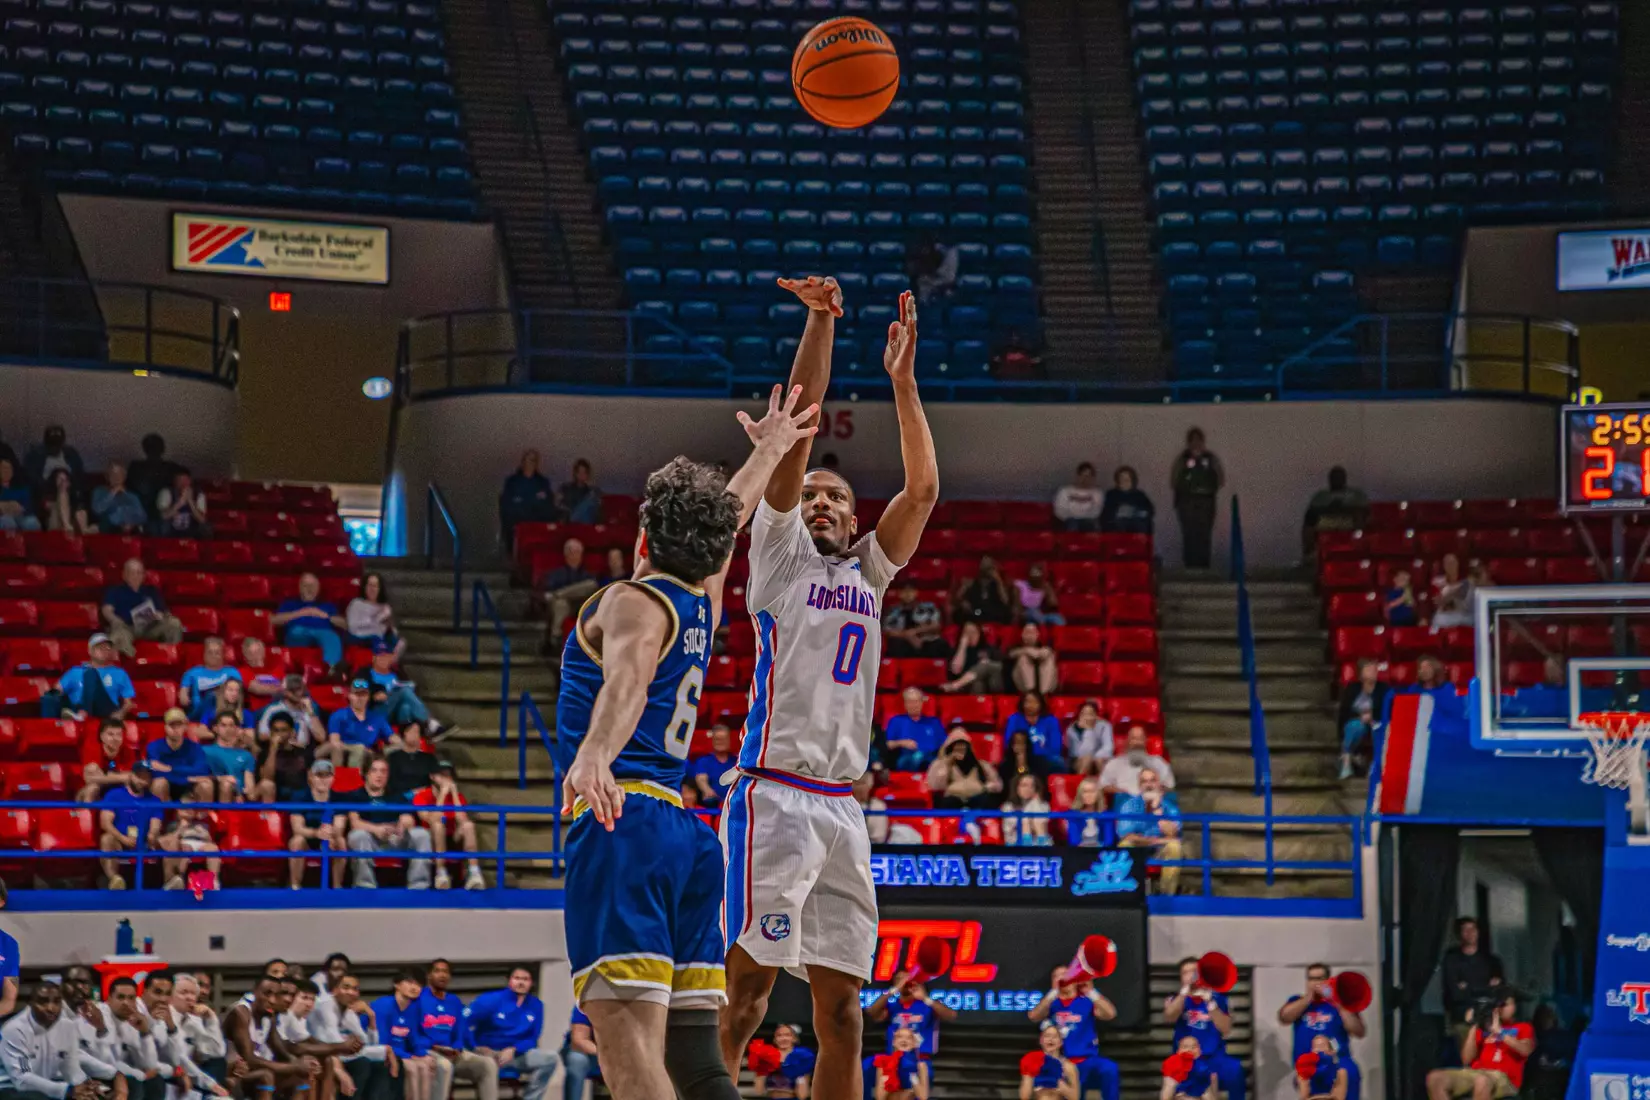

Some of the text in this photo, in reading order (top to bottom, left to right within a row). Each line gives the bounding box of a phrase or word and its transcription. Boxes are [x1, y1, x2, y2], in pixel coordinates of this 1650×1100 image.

[815, 28, 884, 52] Wilson
[1611, 238, 1650, 268] WA
[832, 621, 867, 685] 0
[664, 664, 703, 761] 6
[971, 856, 1062, 887] TECH
[985, 989, 1043, 1010] LESS
